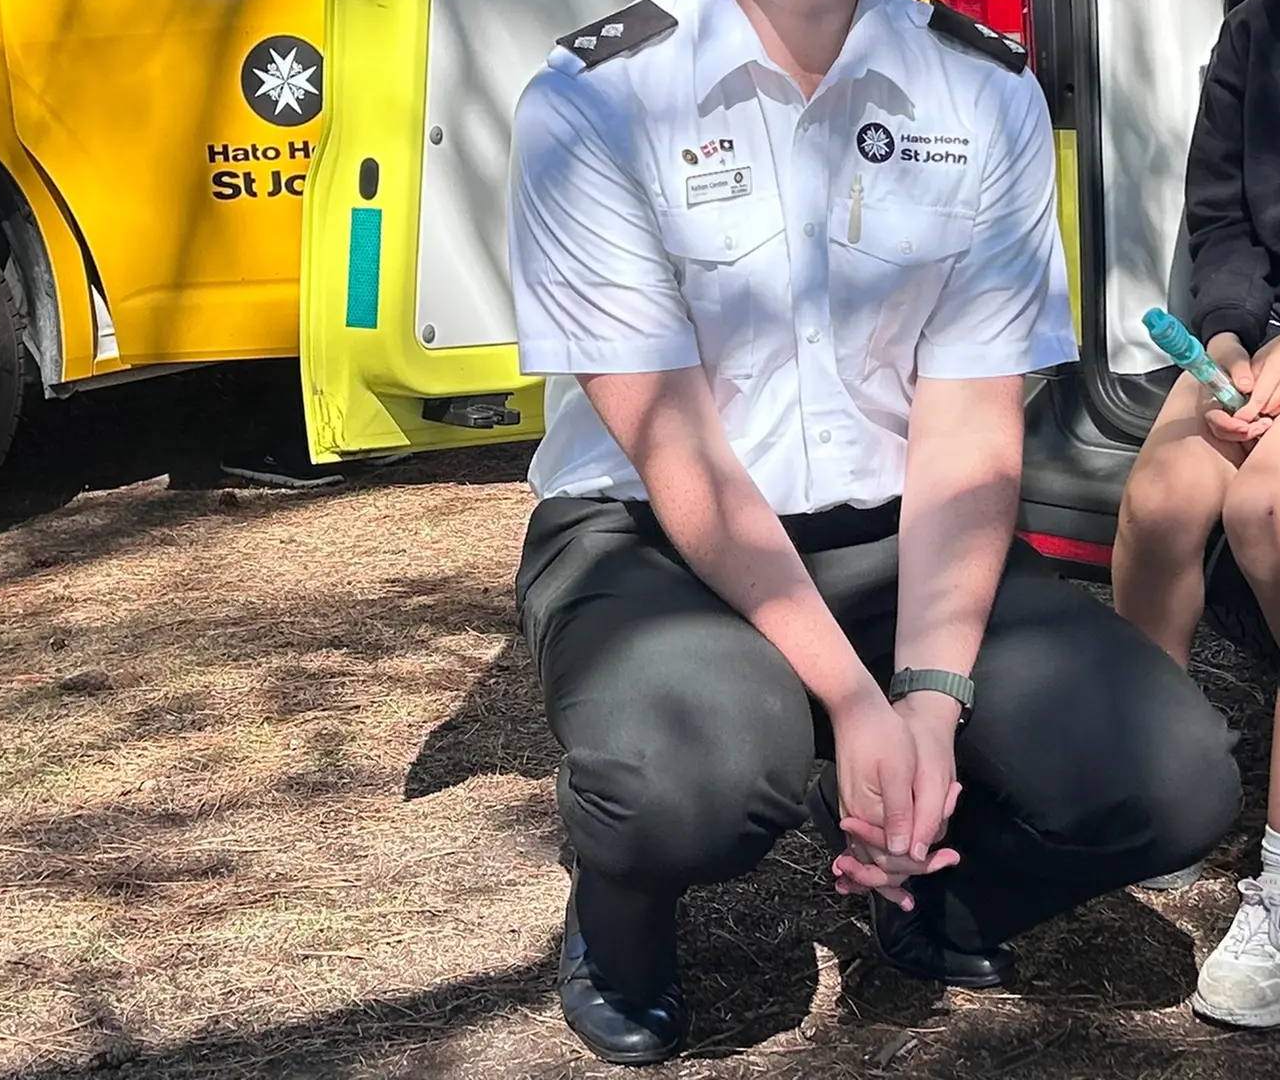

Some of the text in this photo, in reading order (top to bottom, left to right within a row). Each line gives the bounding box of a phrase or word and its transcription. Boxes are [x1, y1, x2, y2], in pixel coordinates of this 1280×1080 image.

[901, 133, 970, 146] Hato Hone
[207, 143, 281, 163] Hato
[900, 148, 968, 165] St John
[212, 170, 258, 200] St
